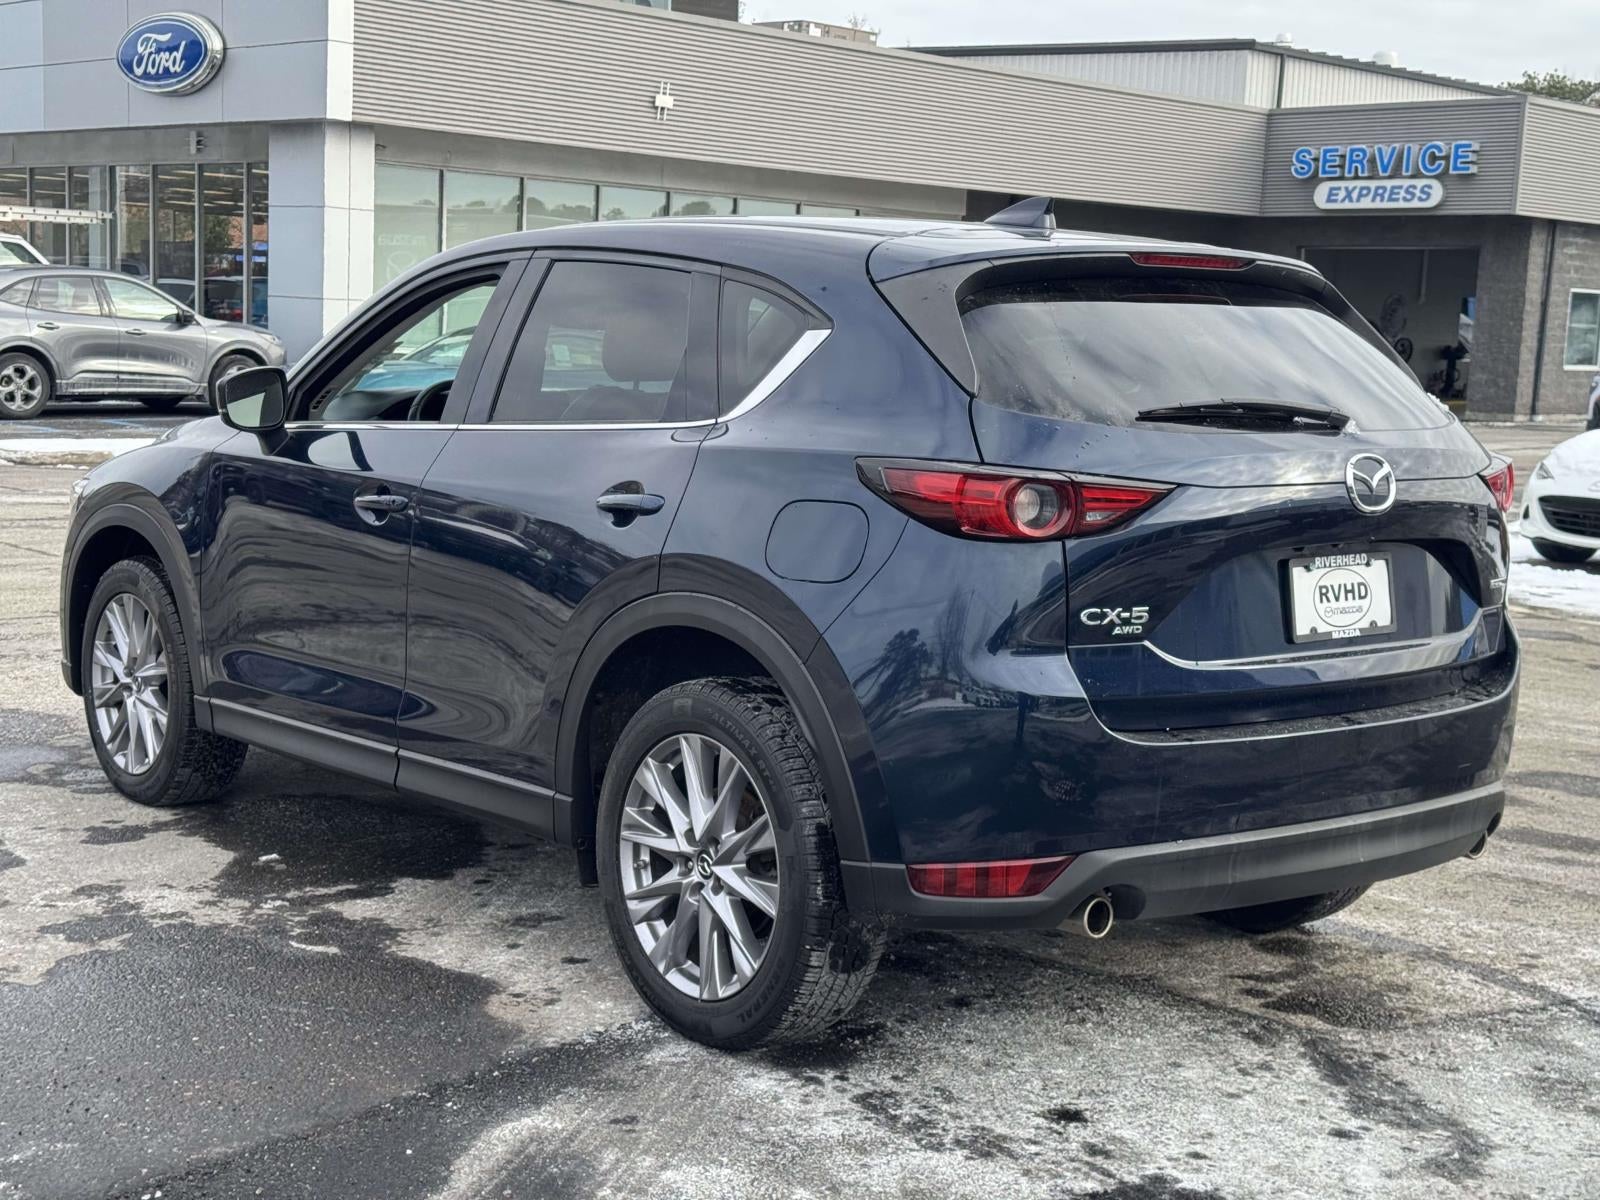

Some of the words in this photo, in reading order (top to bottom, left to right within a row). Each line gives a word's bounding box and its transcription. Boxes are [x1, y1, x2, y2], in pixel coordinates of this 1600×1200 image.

[133, 32, 186, 77] Ford
[1291, 141, 1478, 179] SERVICE
[1325, 184, 1433, 204] EXPRESS
[1315, 553, 1368, 569] RIVERHEAD
[1318, 581, 1369, 604] RVHD
[1080, 606, 1150, 626] CX-5
[1112, 625, 1143, 635] AWD
[1331, 628, 1361, 639] MAZDA
